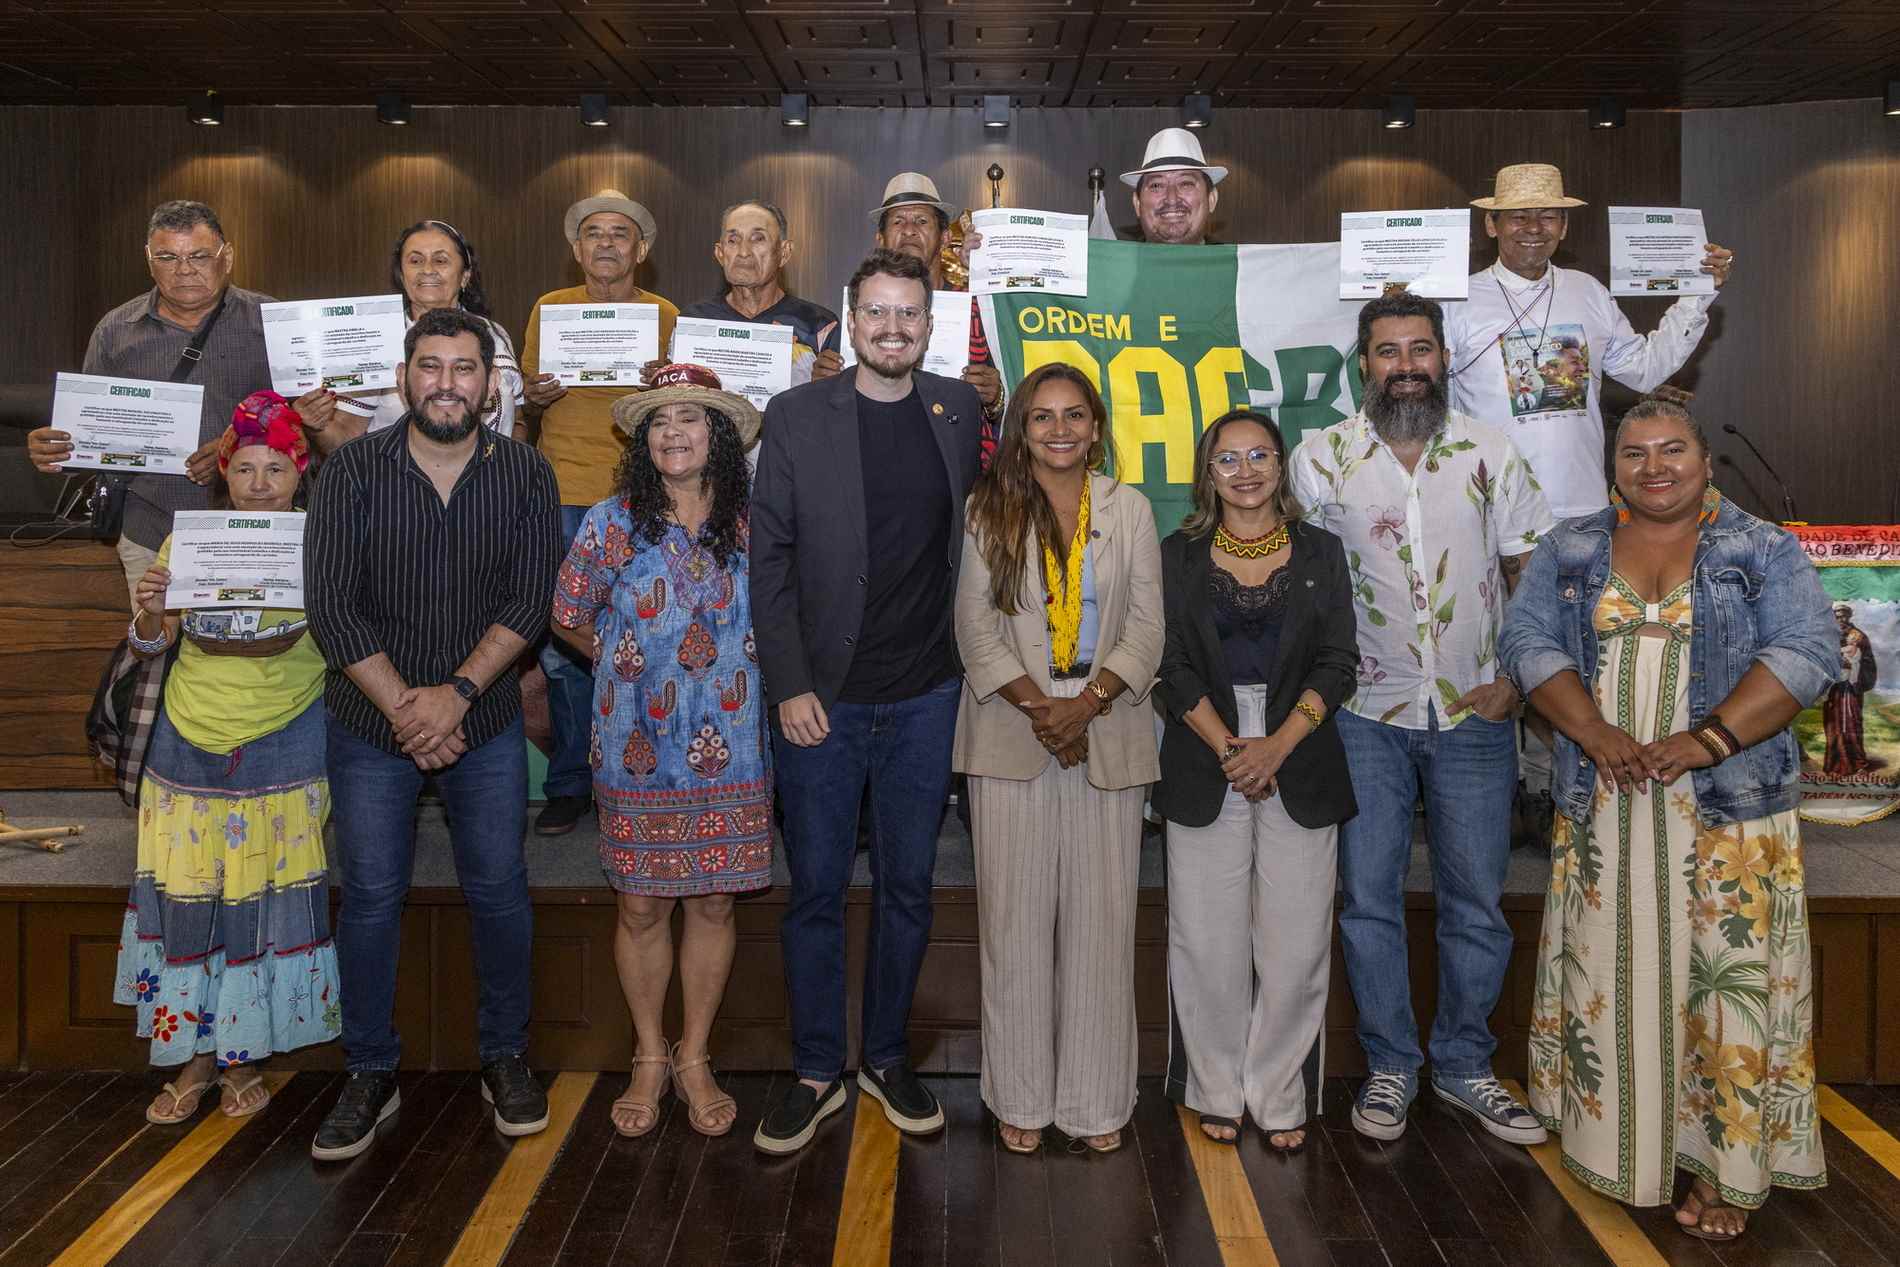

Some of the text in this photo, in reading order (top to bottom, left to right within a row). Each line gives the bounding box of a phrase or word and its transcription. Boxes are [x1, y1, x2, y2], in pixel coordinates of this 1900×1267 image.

[1010, 215, 1045, 226] CERTIFICADO
[1386, 217, 1423, 227] CERTIFICADO
[582, 310, 616, 320] CERTIFICADO
[1018, 306, 1179, 342] ORDEM E
[718, 327, 751, 339] CERTIFICADO
[110, 385, 152, 398] CERTIFICADO
[228, 518, 271, 529] CERTIFICADO
[1879, 530, 1900, 542] CA
